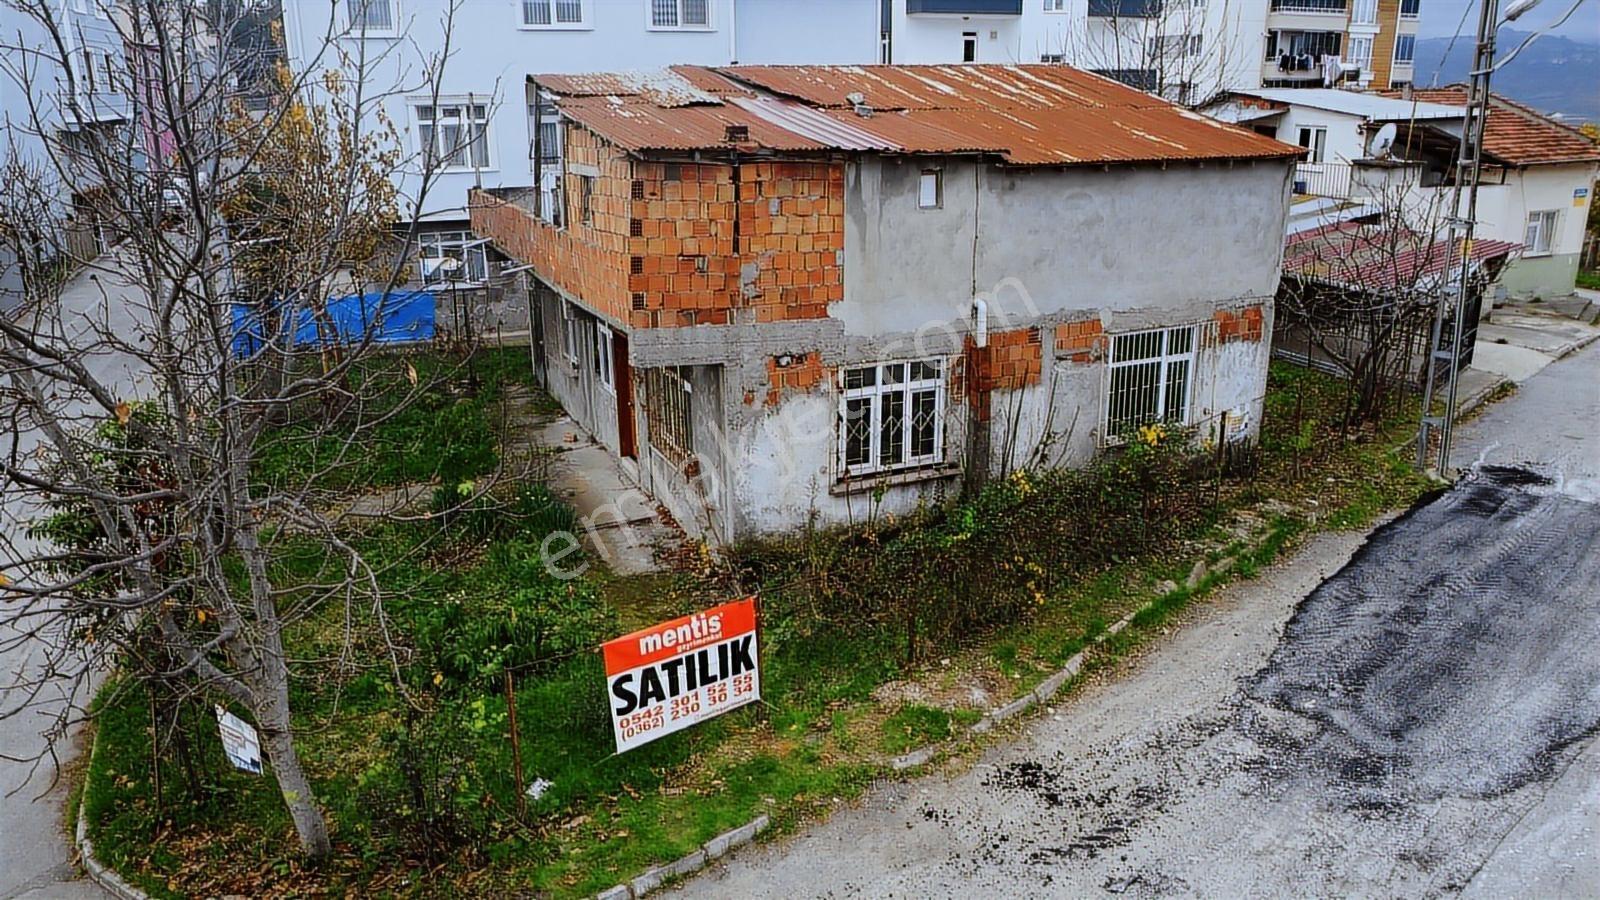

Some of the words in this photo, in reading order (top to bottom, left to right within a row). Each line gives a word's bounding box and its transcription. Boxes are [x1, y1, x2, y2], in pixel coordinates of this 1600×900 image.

[640, 614, 722, 656] mentis
[612, 634, 755, 716] SATILIK
[620, 705, 664, 728] 0542
[671, 691, 698, 711] 301
[707, 682, 727, 696] 52
[622, 715, 664, 742] (0362)
[671, 702, 700, 721] 230
[708, 693, 727, 706] 30
[734, 683, 752, 697] 34
